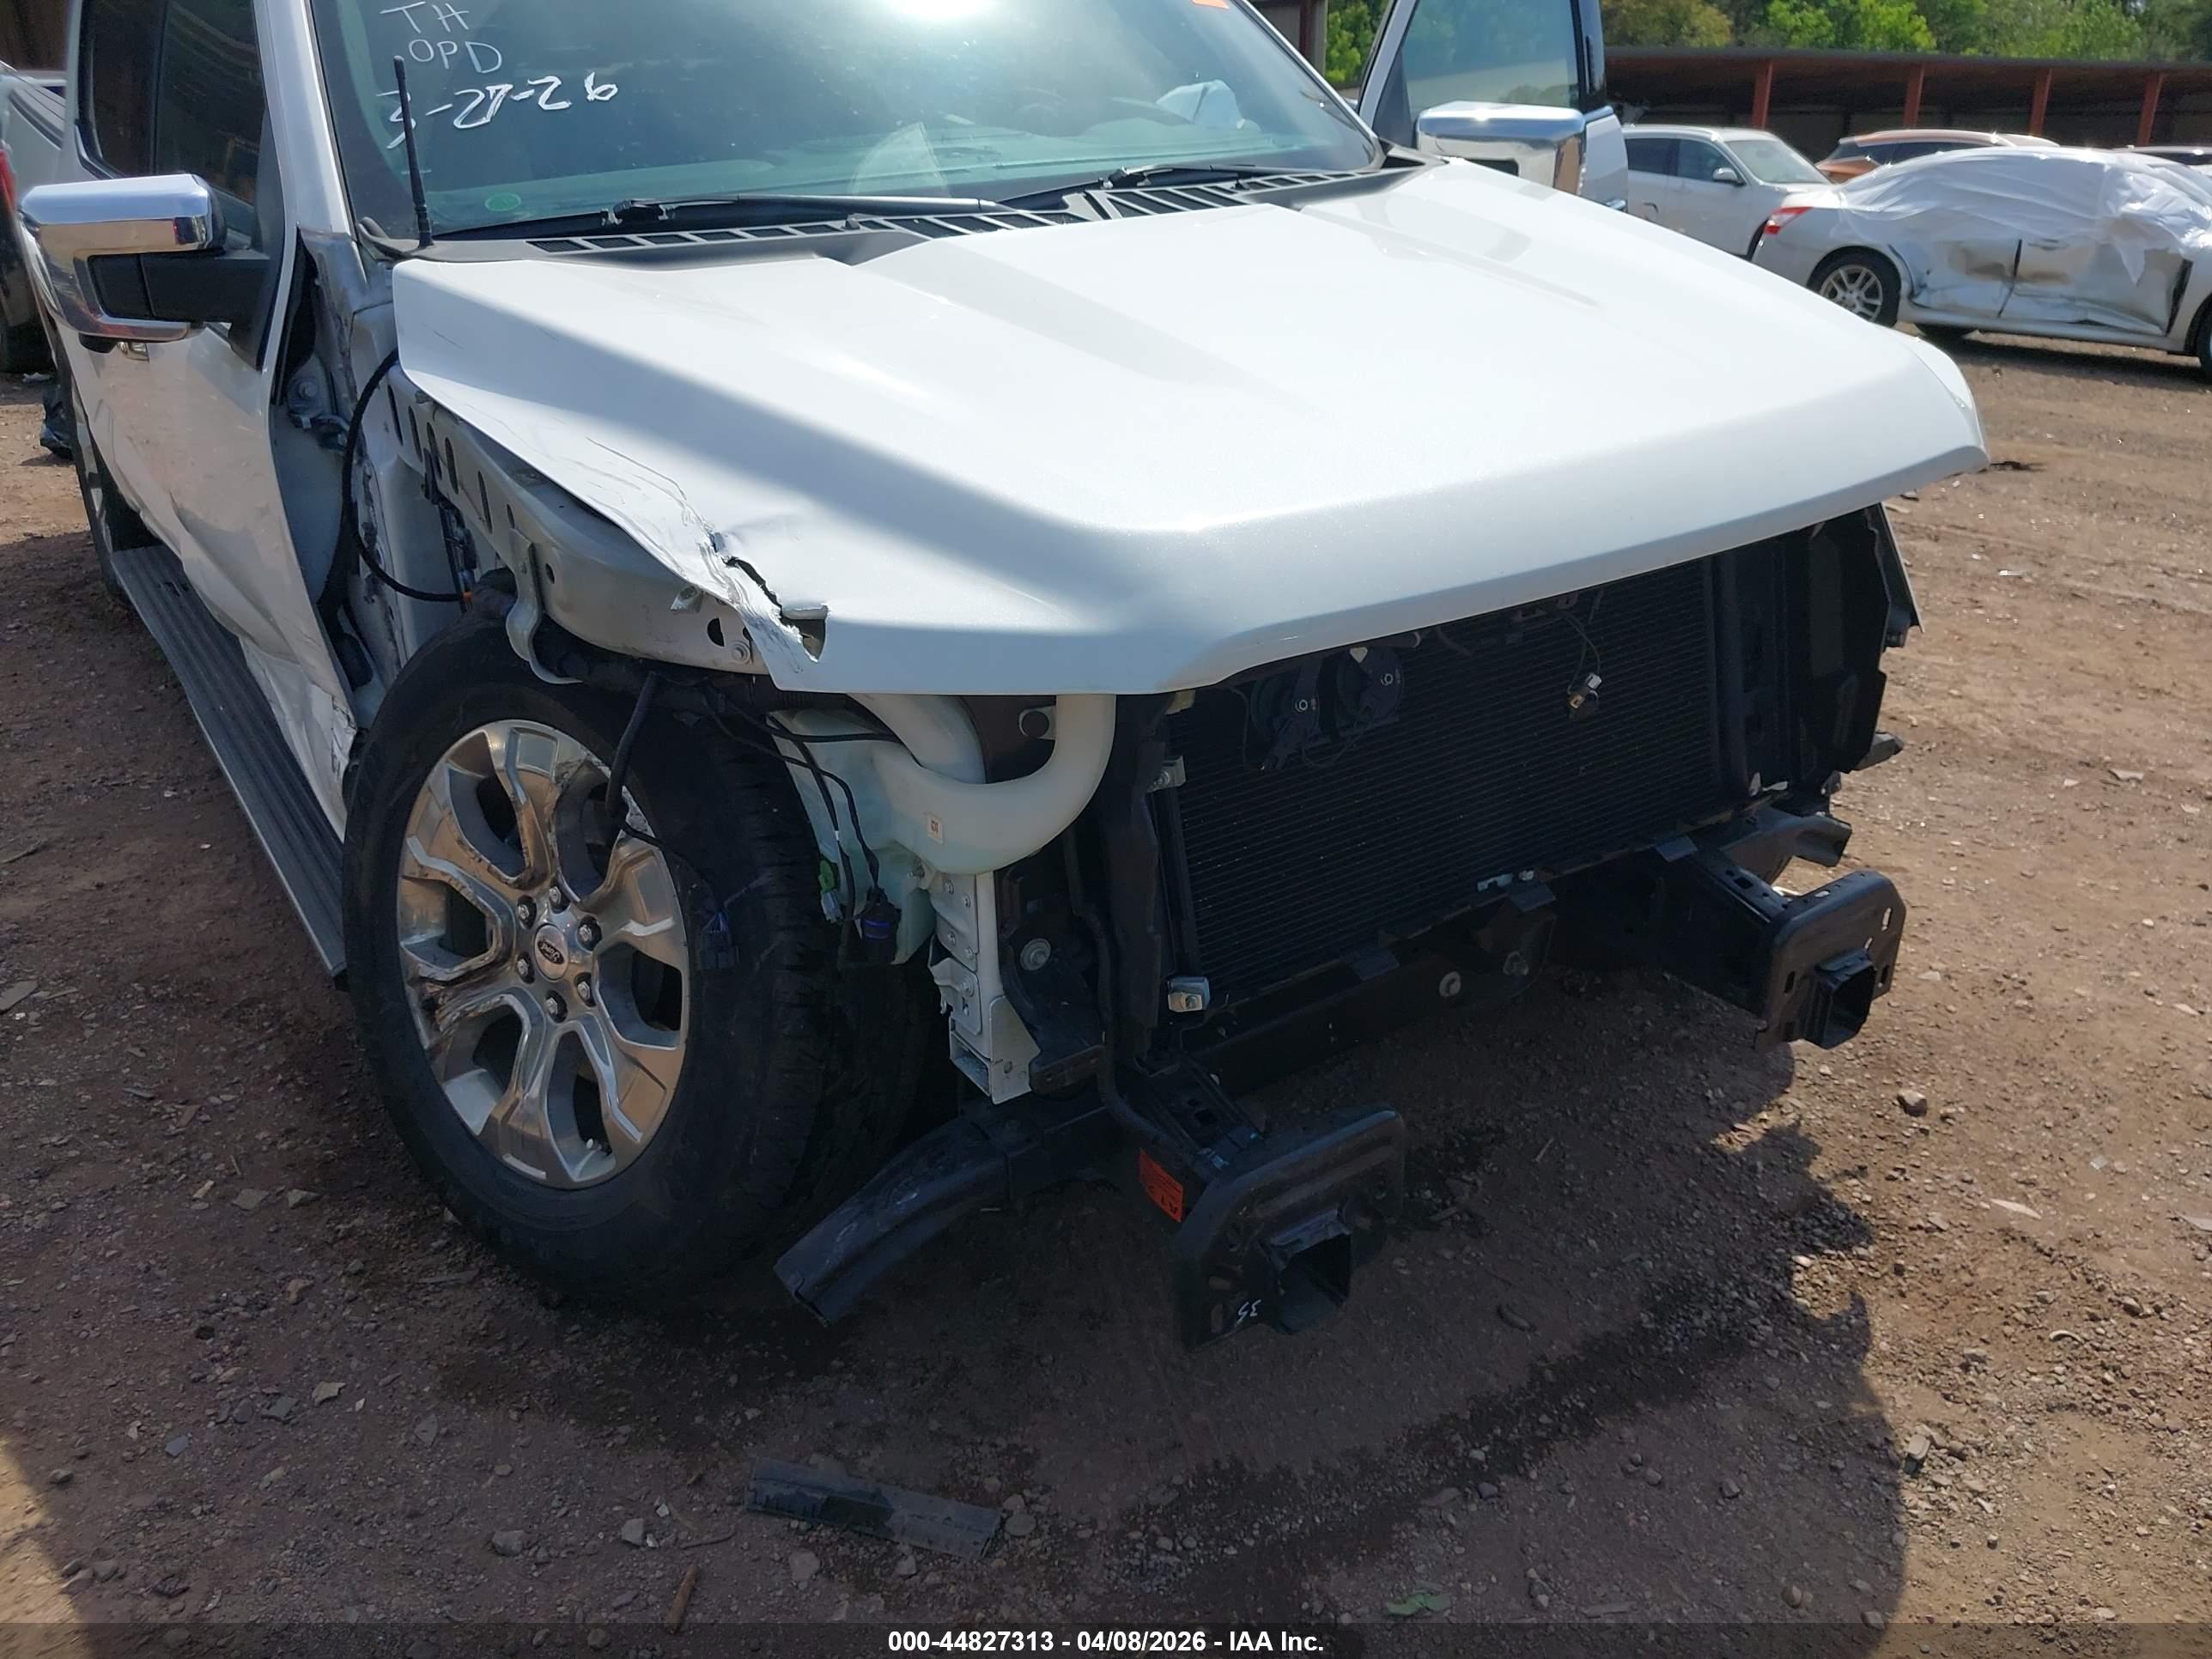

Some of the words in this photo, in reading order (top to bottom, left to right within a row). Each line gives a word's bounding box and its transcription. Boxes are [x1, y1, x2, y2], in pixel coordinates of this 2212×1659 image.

[380, 1, 470, 34] TH
[408, 39, 503, 74] OPD
[540, 943, 562, 963] Ford
